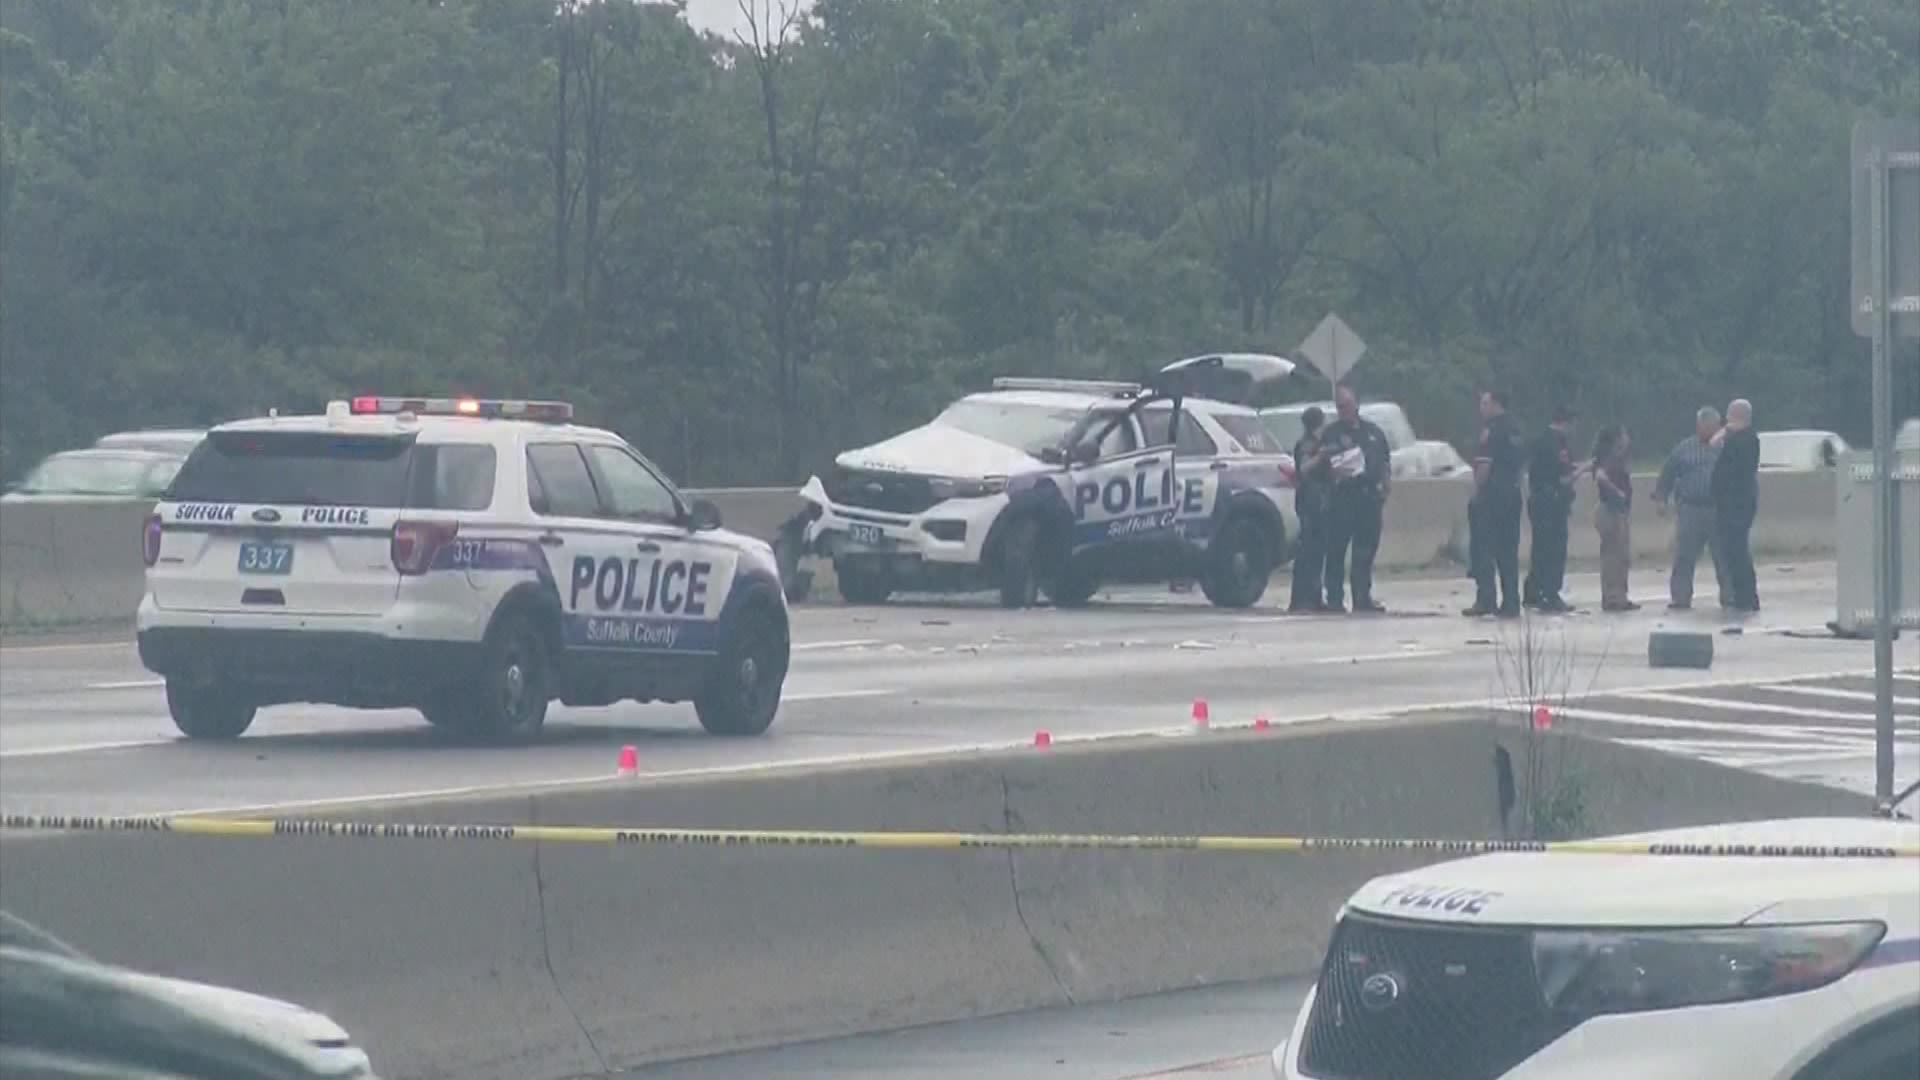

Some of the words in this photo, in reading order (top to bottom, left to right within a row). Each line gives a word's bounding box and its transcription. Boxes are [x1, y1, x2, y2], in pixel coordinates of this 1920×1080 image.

[1075, 470, 1204, 521] POLIE
[175, 504, 237, 521] SUFFOLK
[302, 506, 369, 525] POLICE
[244, 547, 289, 569] 337
[454, 541, 481, 562] 337
[570, 555, 711, 615] POLICE
[587, 618, 631, 640] Suffolk
[635, 623, 678, 648] County
[1381, 885, 1504, 914] POLICE
